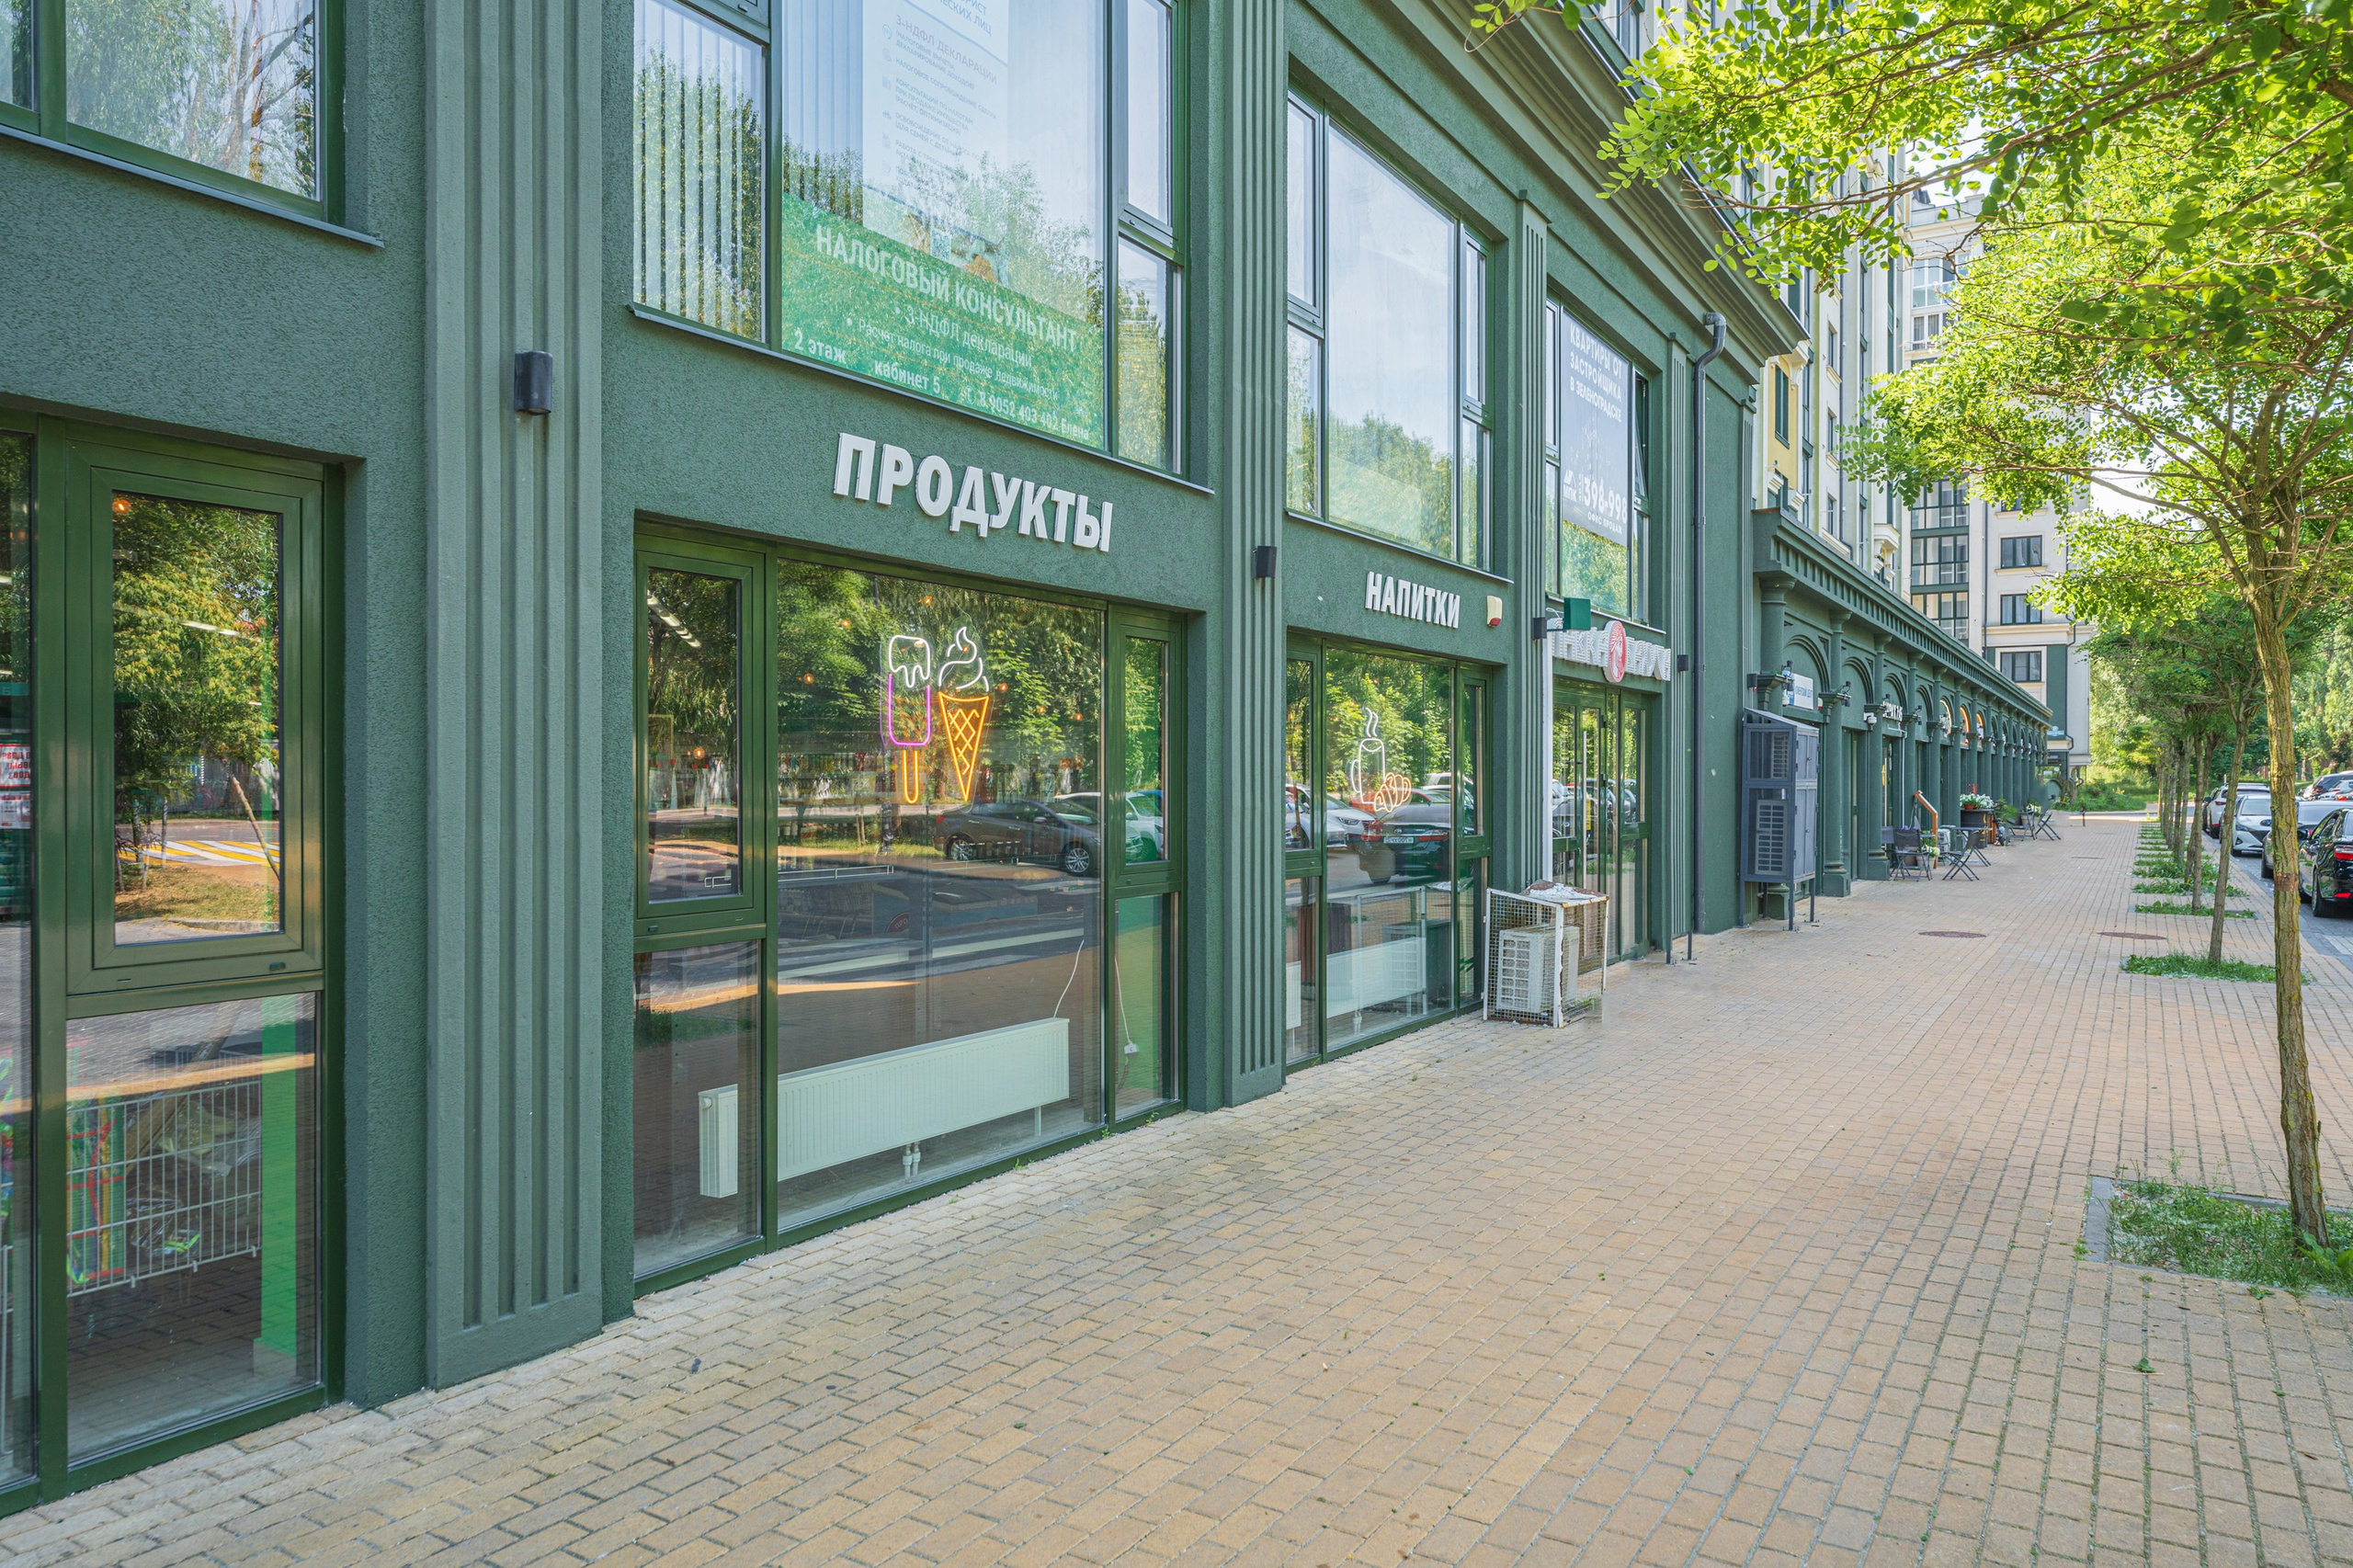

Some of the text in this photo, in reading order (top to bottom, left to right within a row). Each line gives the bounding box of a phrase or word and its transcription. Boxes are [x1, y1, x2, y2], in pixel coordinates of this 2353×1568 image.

[896, 14, 997, 85] 3-НДФЛ ДЕКЛАРАЦИИ
[973, 16, 993, 37] ЛИЦ
[895, 76, 938, 103] КОНСУЛЬТАЦИИ
[816, 223, 1077, 352] НАЛОГОВЫЙ КОНСУЛЬТАНТ
[905, 304, 1032, 368] 3-НДФЛ декларации
[1570, 323, 1622, 379] КВАРТИРЫ ОТ
[794, 327, 803, 350] 2
[808, 338, 847, 364] этаж
[874, 358, 929, 391] кабинет
[933, 376, 940, 394] 5
[988, 394, 1016, 418] 9052
[1018, 404, 1038, 423] 403
[1061, 417, 1089, 440] Елена
[897, 336, 931, 357] налога
[933, 347, 951, 365] при
[953, 354, 993, 379] продаже
[995, 370, 1058, 400] недвижимости
[1570, 351, 1621, 402] ЗАСТРОЙЩИКА
[1570, 376, 1621, 423] В ЗЕЛЕНОГРАДСКЕ
[833, 432, 1113, 552] ПРОДУКТЫ
[1584, 476, 1627, 524] 398-998
[1587, 511, 1622, 534] ОФИС ПРОДАЖ
[1365, 571, 1461, 629] НАПИТКИ
